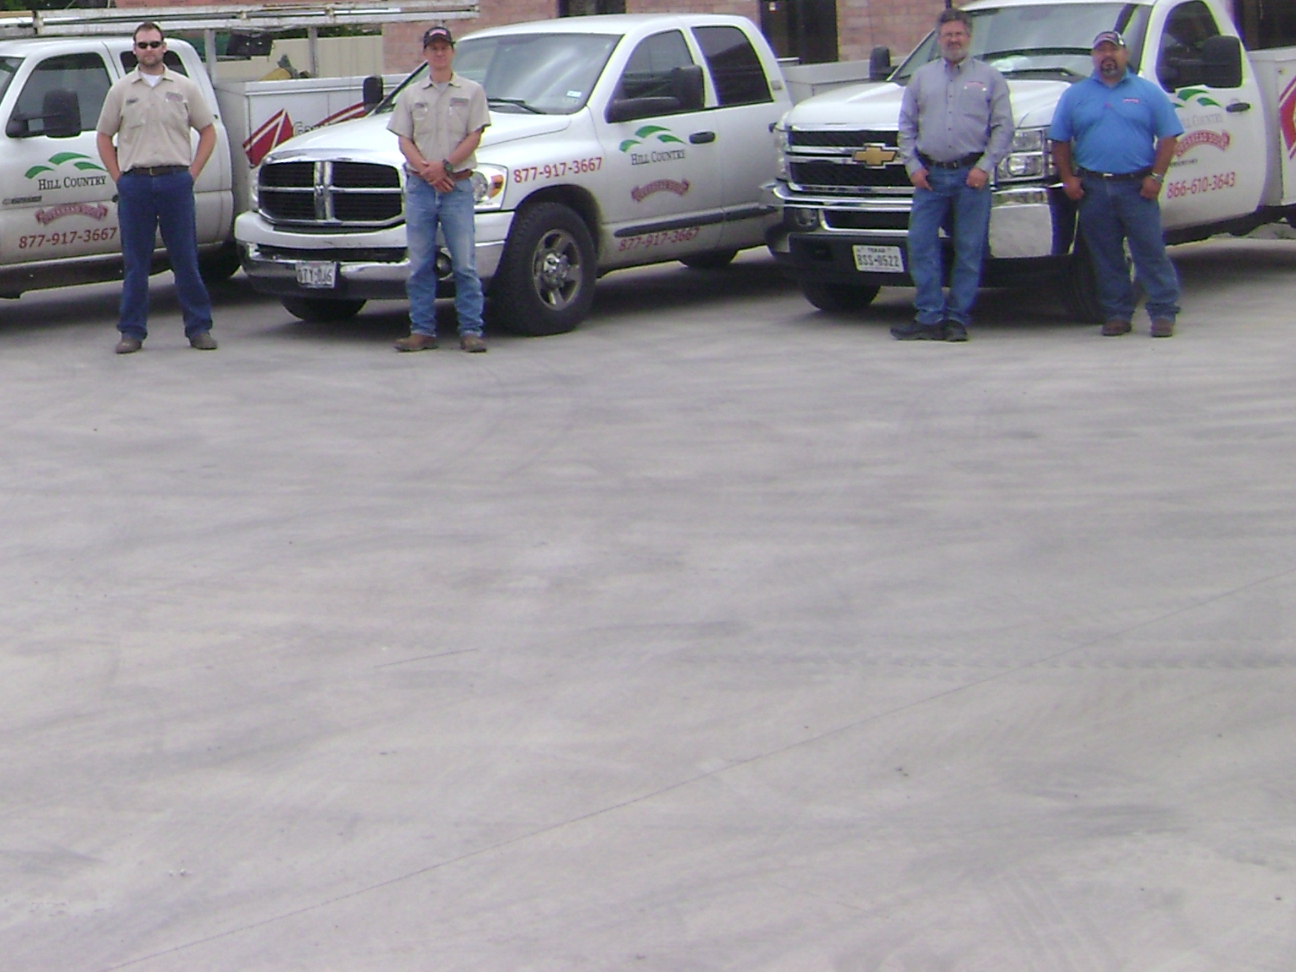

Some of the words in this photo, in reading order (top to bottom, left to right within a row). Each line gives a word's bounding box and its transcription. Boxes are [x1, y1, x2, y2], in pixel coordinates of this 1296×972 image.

[38, 179, 61, 190] HILL
[63, 176, 106, 189] COUNTRY
[513, 157, 602, 183] 877-917-3667
[1167, 171, 1236, 199] 866-610-3643
[19, 227, 118, 248] 877-917-3667
[618, 226, 700, 252] 877-917-3667
